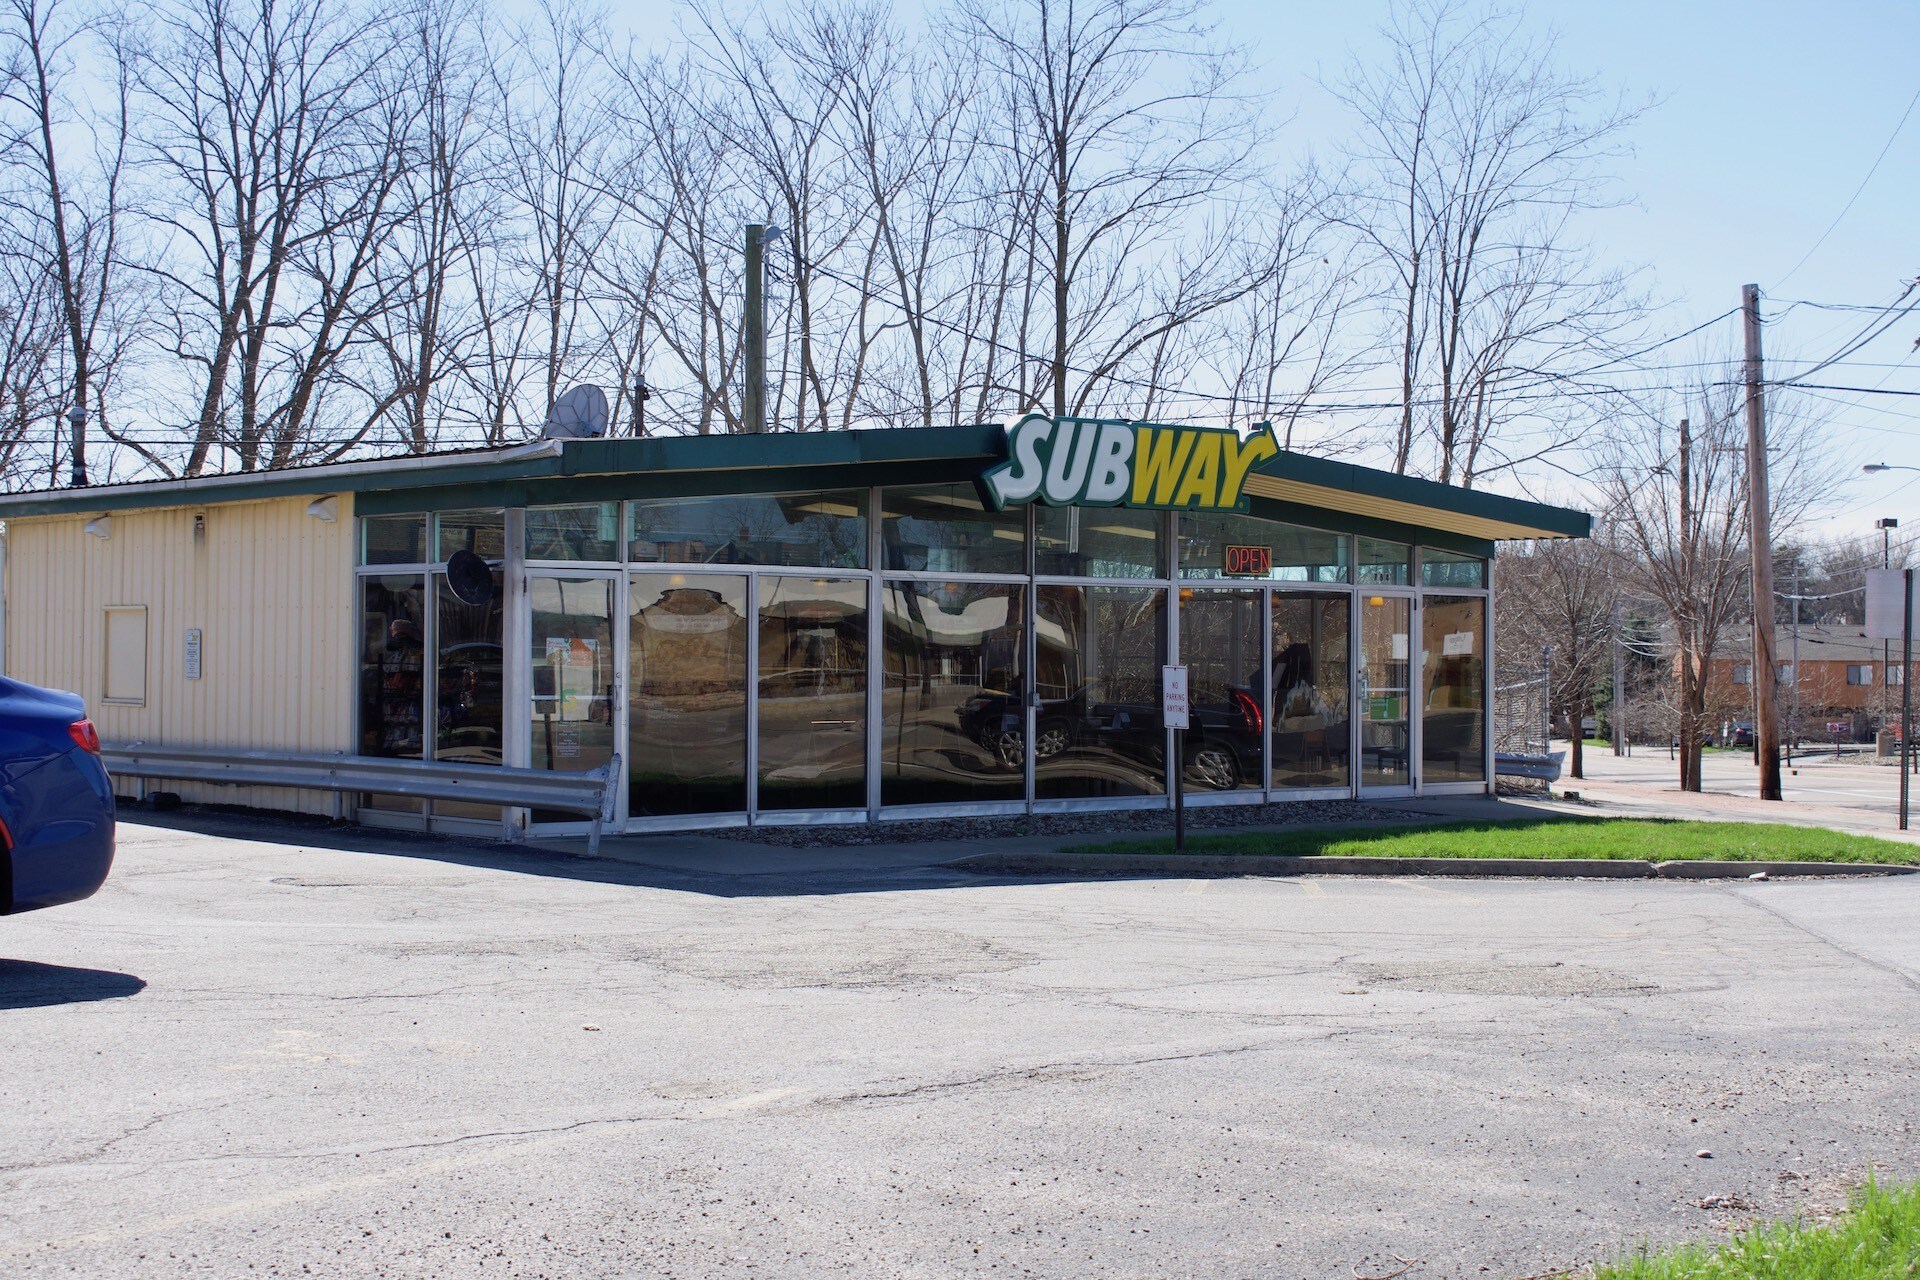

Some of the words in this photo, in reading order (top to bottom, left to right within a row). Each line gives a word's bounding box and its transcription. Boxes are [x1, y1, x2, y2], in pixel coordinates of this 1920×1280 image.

[991, 418, 1278, 509] SUBWAY
[1228, 547, 1270, 572] OPEN
[1172, 681, 1179, 690] NO
[1166, 693, 1185, 702] PARKING
[1167, 705, 1185, 713] ANYTIME
